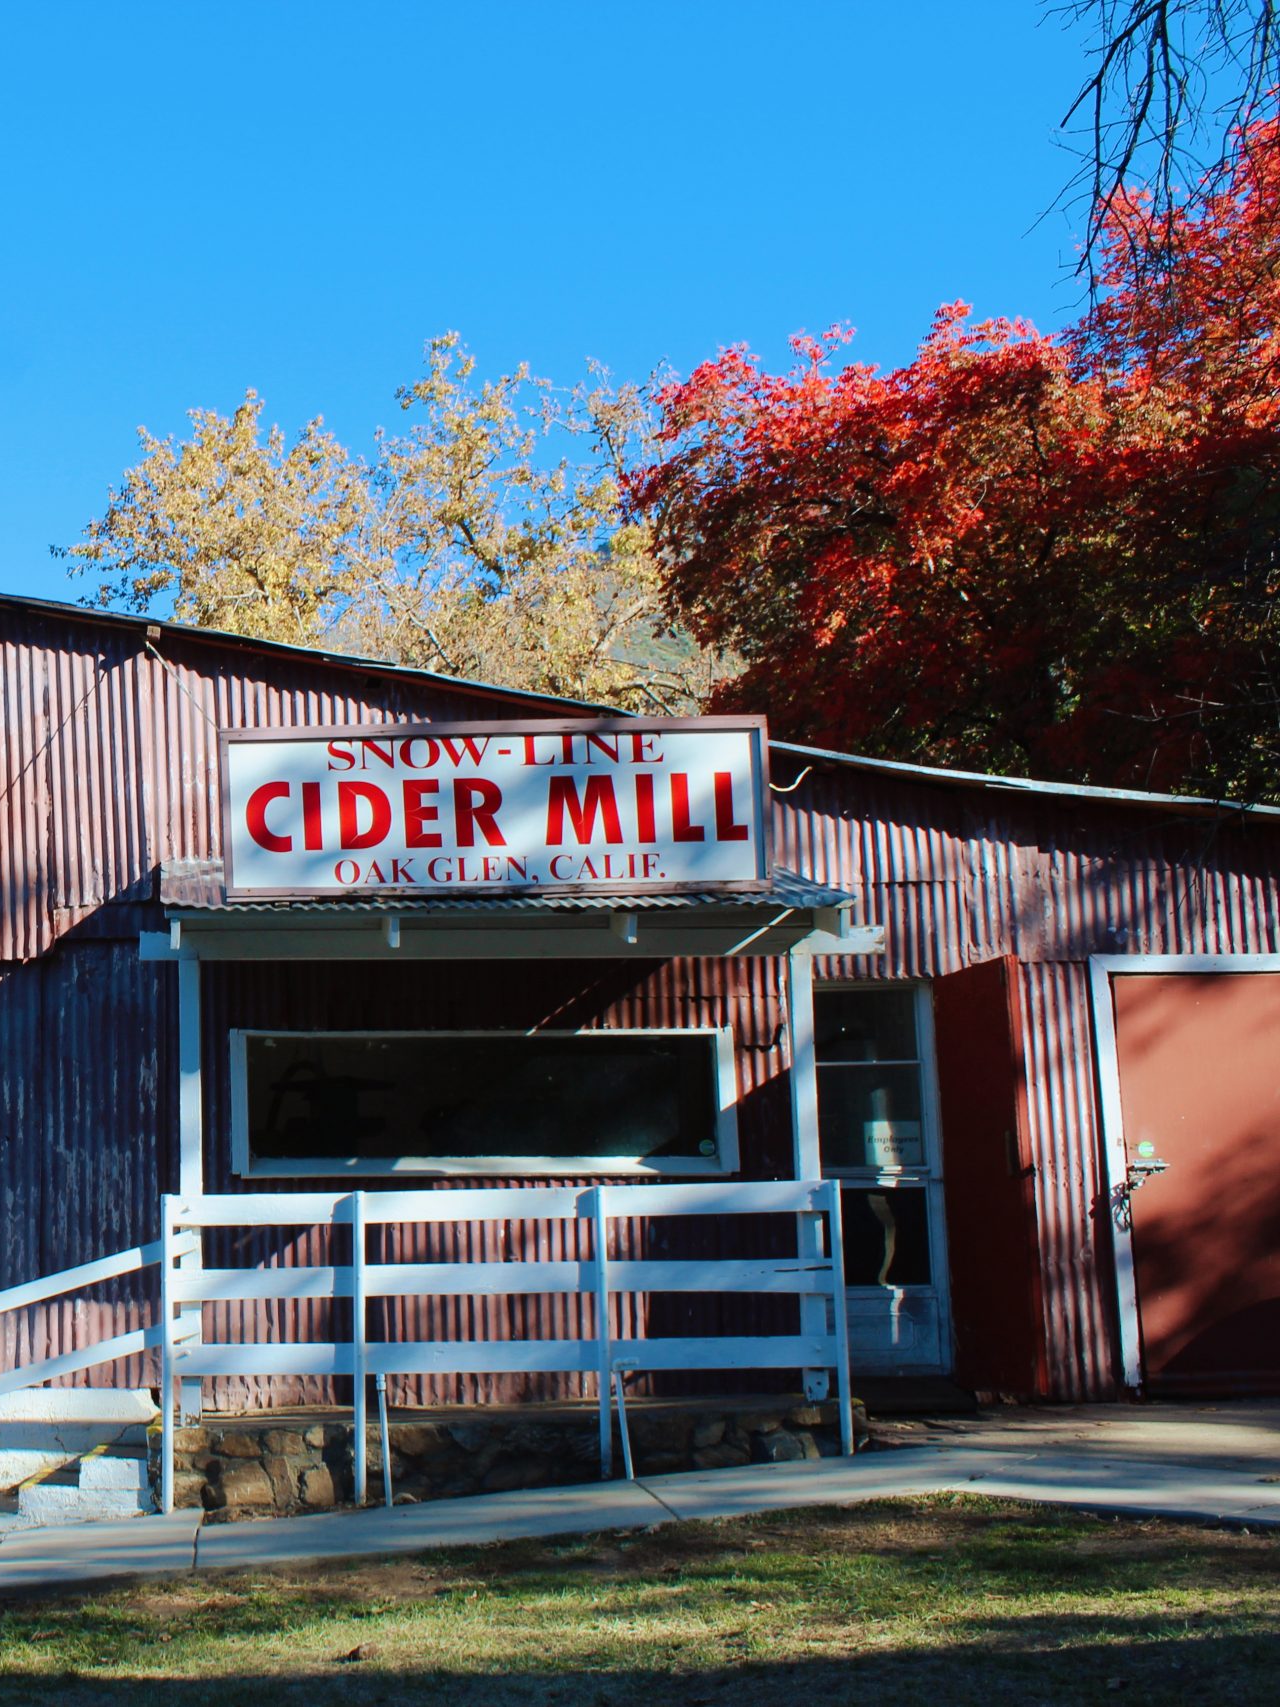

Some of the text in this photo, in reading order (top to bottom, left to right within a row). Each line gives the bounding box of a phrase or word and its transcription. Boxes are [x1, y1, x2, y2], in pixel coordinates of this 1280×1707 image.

[327, 731, 664, 771] SNOW-LINE
[246, 771, 749, 853] CIDER MILL
[334, 852, 667, 885] OAK GLEN, CALIF.
[883, 1145, 905, 1154] Only
